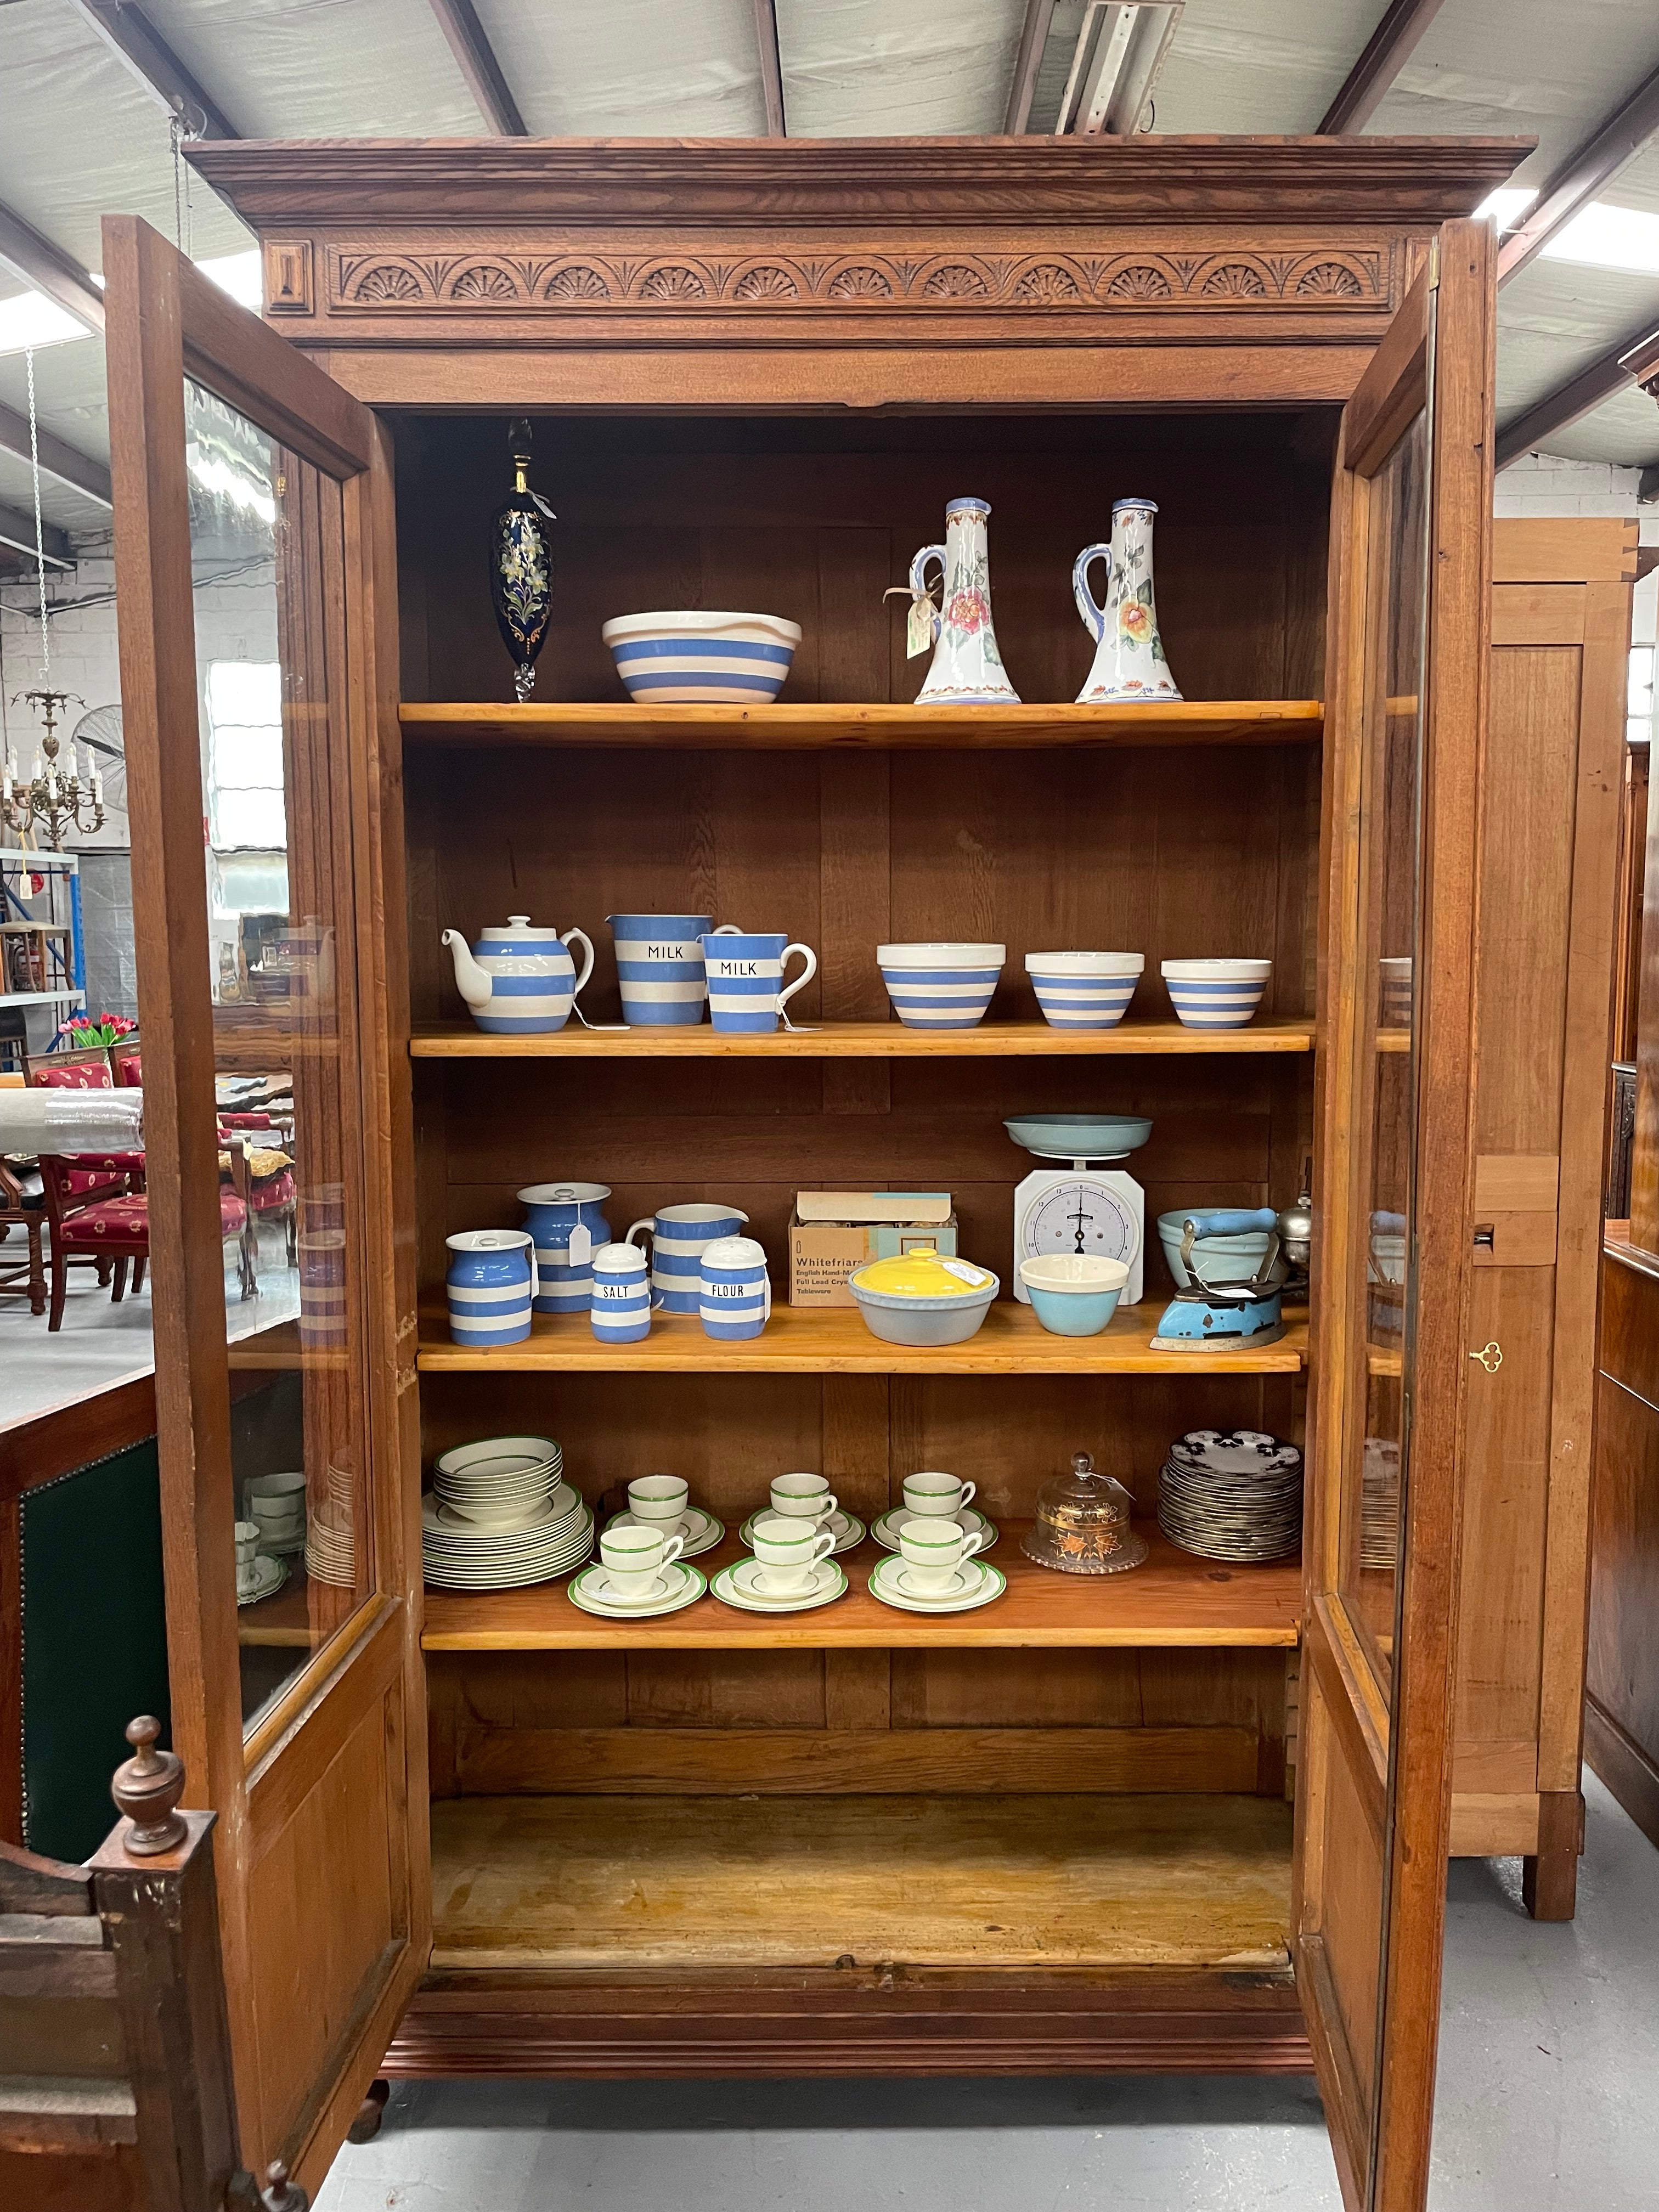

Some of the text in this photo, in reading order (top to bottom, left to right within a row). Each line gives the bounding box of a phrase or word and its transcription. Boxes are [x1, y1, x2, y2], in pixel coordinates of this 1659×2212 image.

[648, 946, 683, 958] MILK
[721, 962, 757, 975] MILK
[603, 1286, 629, 1298] SALT
[712, 1285, 743, 1297] FLOUR
